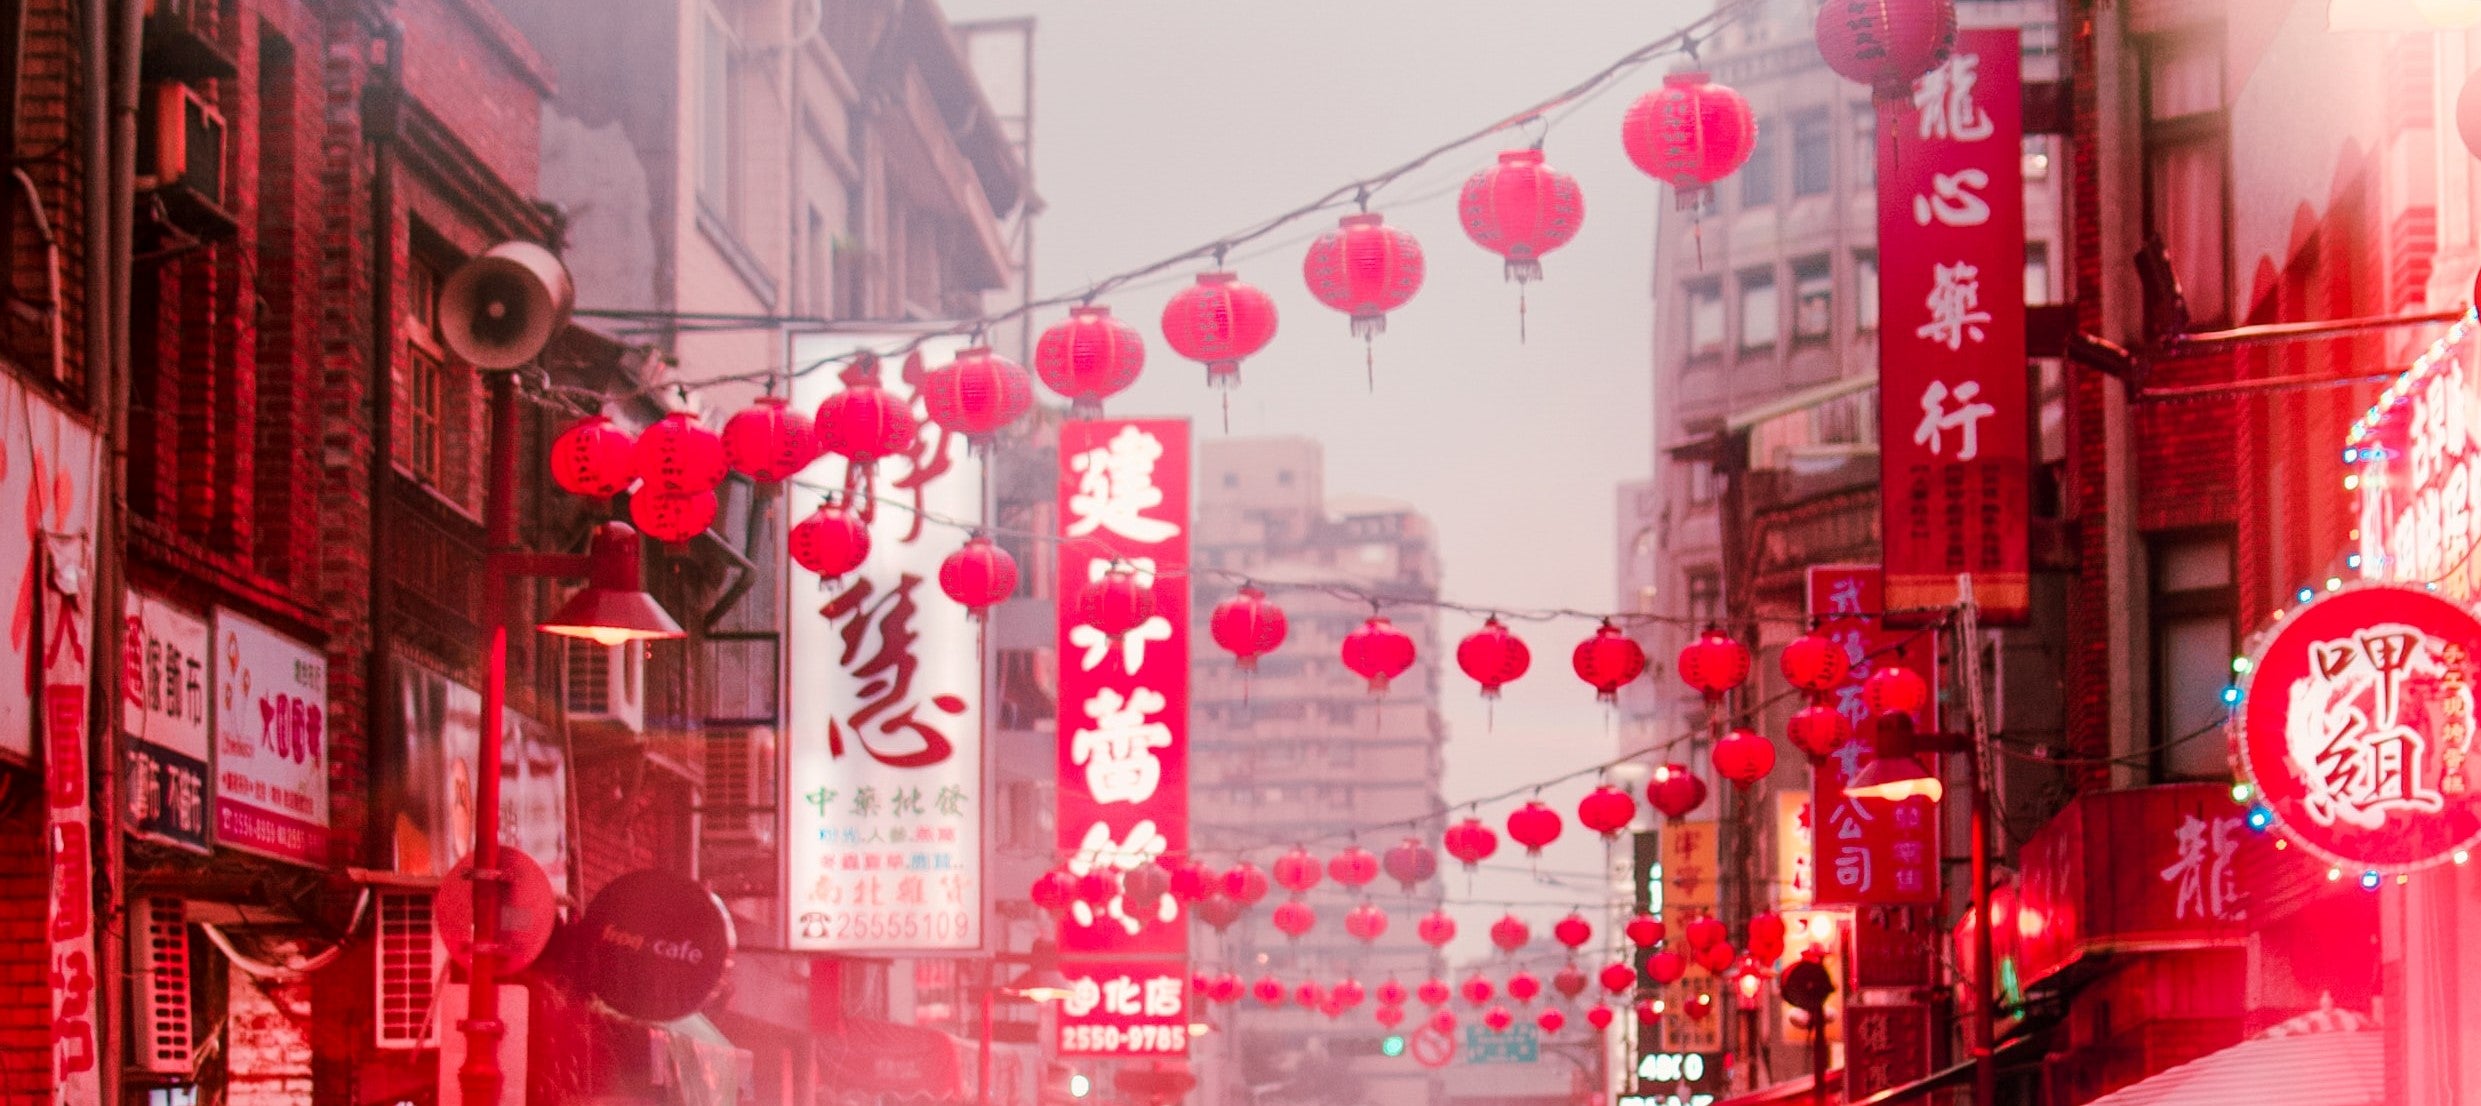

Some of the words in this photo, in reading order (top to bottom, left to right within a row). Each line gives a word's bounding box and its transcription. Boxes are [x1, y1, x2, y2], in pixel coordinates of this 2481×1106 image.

[1912, 53, 1995, 460] 龍心藥行
[2309, 629, 2440, 816] 呷組
[805, 783, 969, 817] 中藥批發
[836, 911, 970, 940] 25555109
[653, 938, 704, 964] cafe
[1061, 1024, 1186, 1052] 2550-9785
